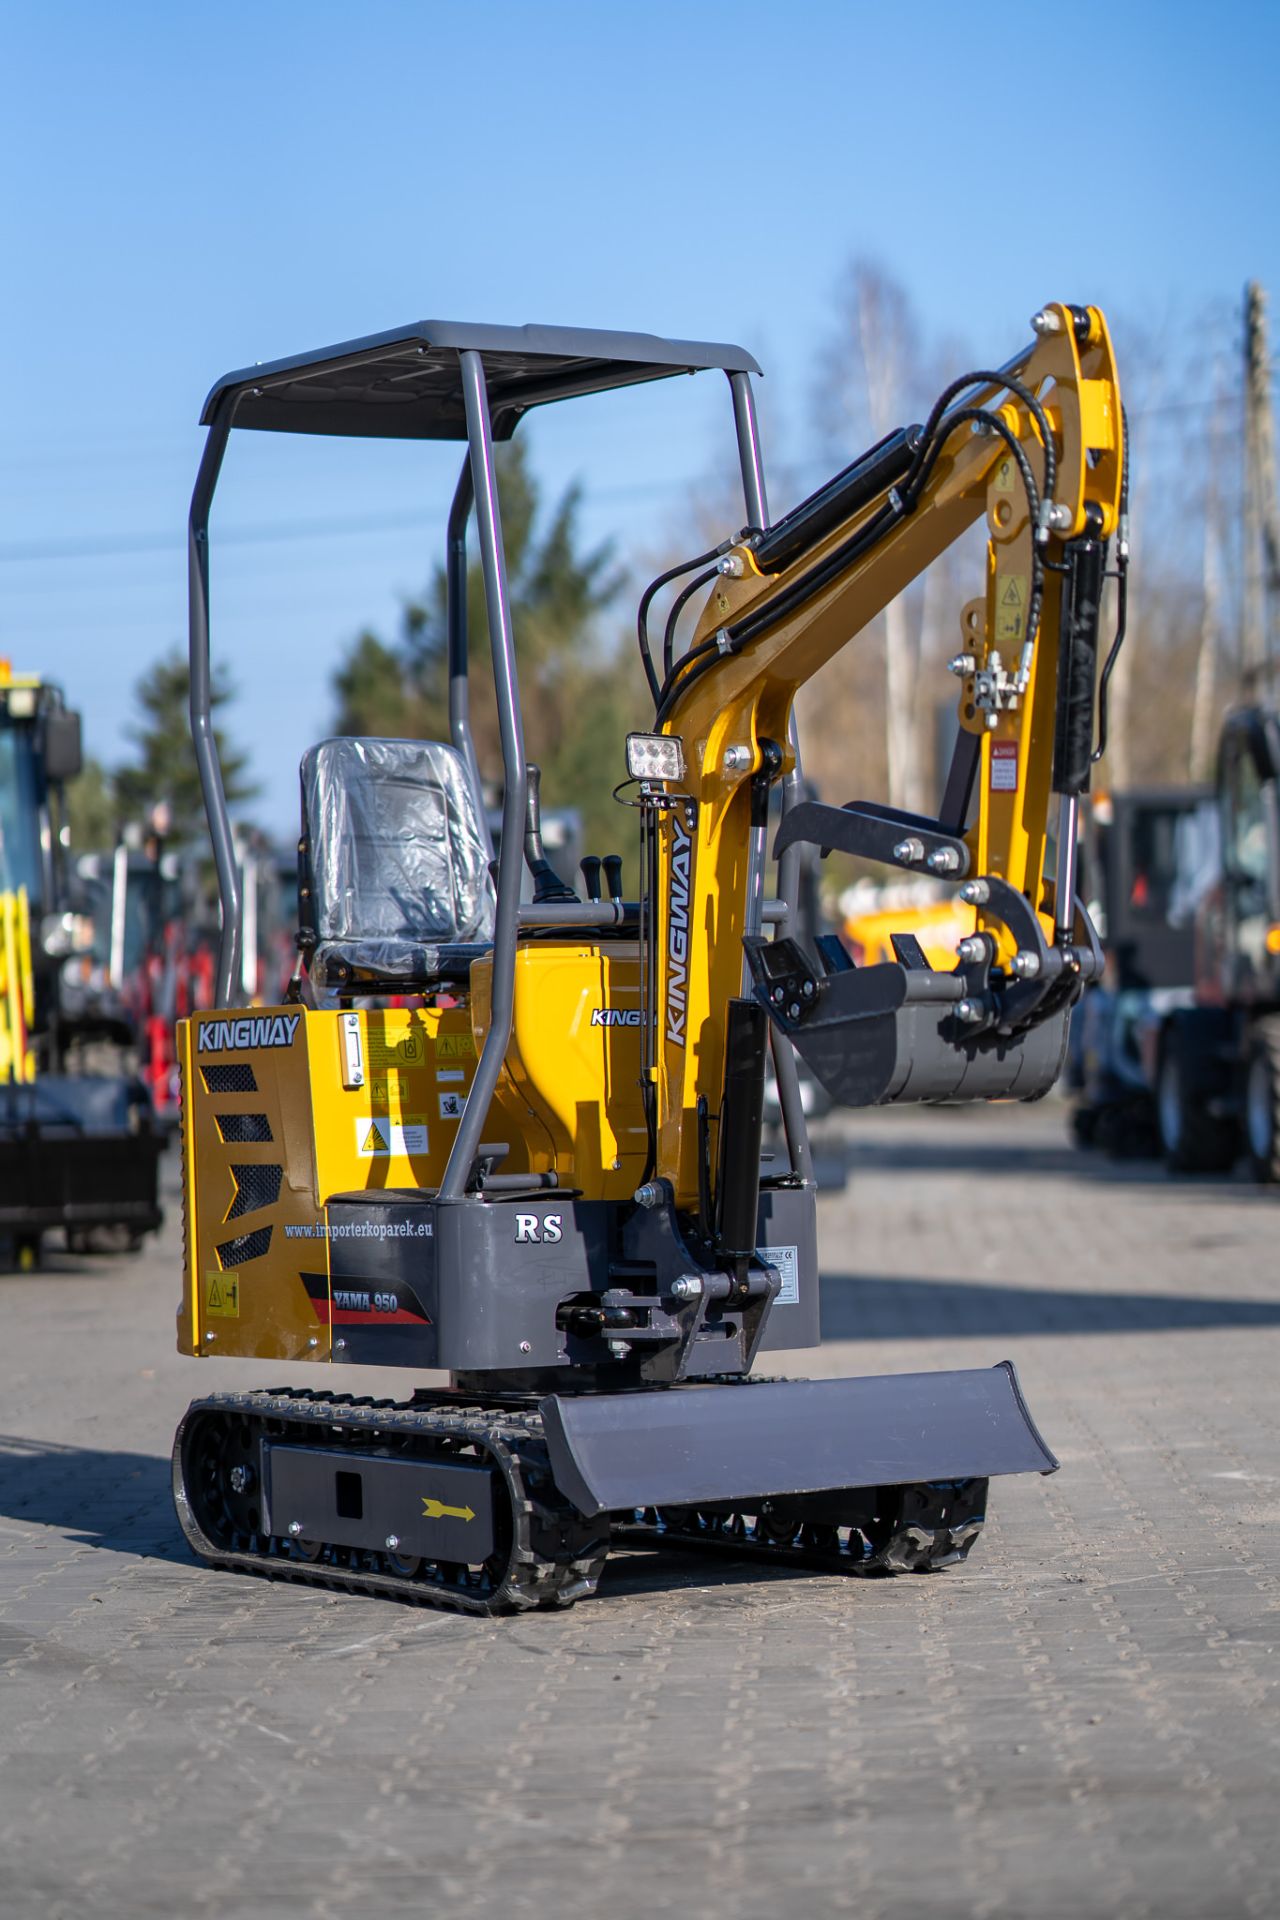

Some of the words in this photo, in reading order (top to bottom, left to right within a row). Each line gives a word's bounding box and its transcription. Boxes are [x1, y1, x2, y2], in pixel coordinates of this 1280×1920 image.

[666, 818, 692, 1047] KINGWAY
[198, 1015, 300, 1052] KINGWAY
[284, 1219, 433, 1242] www.importerkoparek.eu
[515, 1213, 563, 1243] RS
[333, 1290, 371, 1312] YAMA
[373, 1292, 398, 1313] 950
